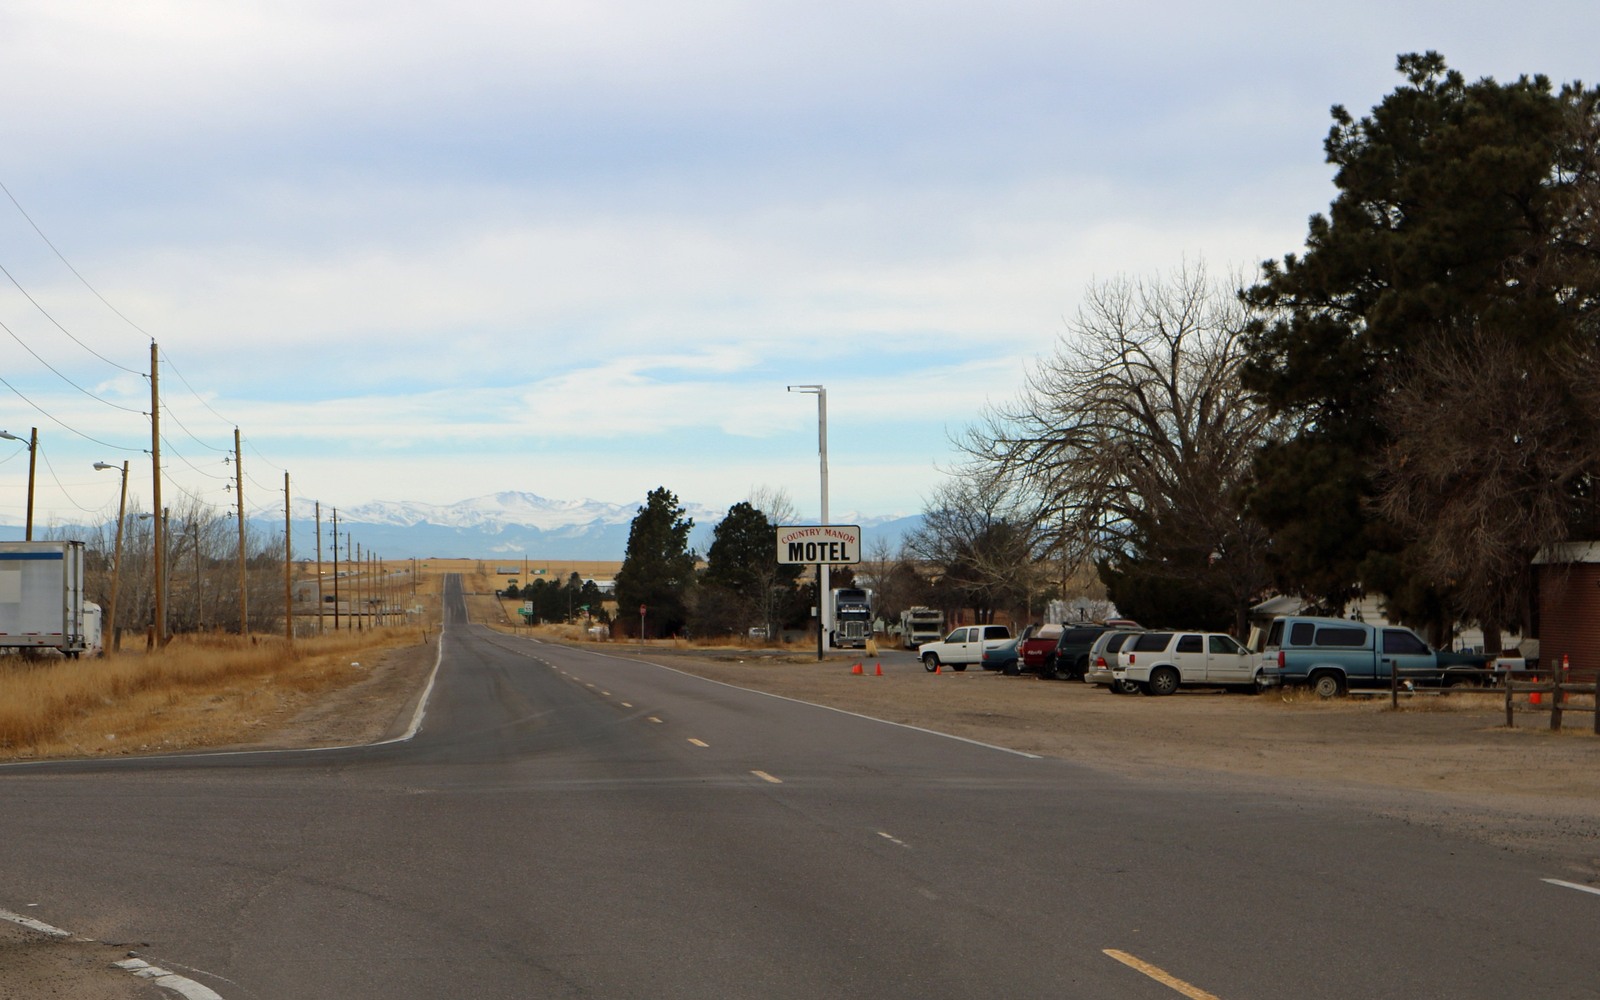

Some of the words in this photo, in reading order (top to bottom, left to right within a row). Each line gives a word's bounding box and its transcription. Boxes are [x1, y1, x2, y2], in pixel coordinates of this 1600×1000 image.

[781, 528, 821, 544] COUNTRY
[824, 529, 856, 544] MANOR
[788, 542, 850, 561] MOTEL
